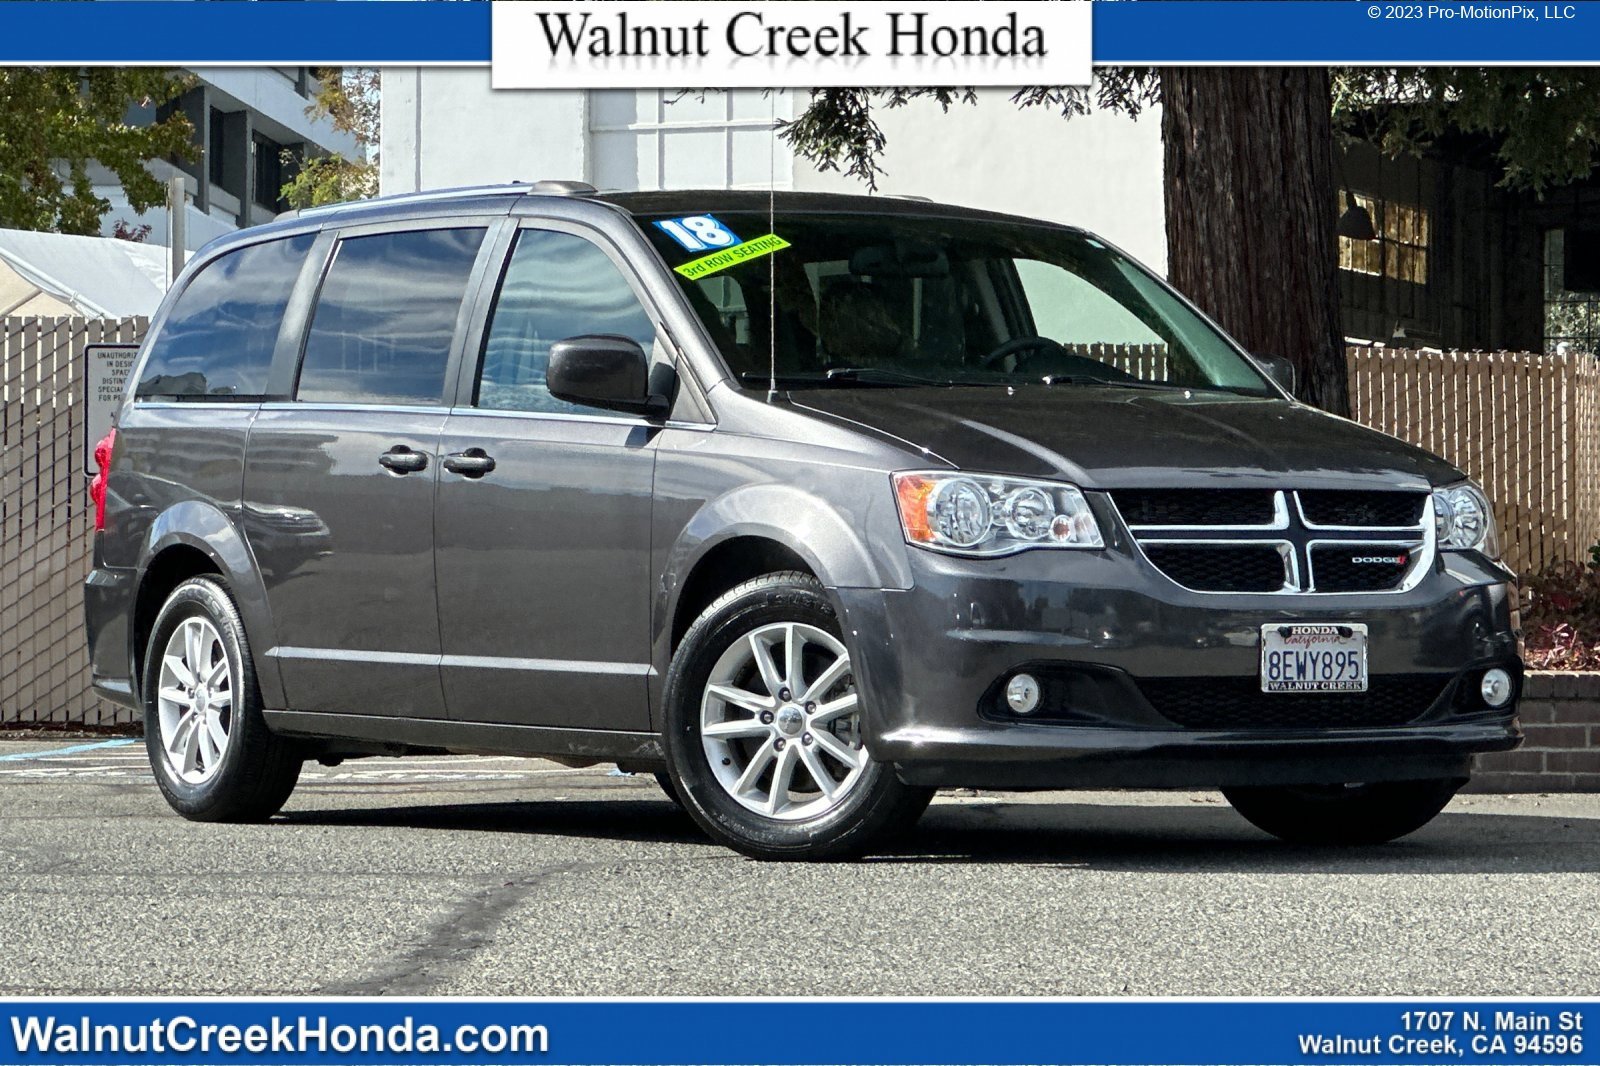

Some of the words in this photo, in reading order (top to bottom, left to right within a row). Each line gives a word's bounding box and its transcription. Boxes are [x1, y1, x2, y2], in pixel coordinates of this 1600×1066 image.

[660, 216, 733, 250] 18
[682, 263, 706, 277] 3rd
[704, 252, 734, 269] ROW
[732, 236, 783, 259] SEATING
[1291, 626, 1339, 635] HONDA
[1268, 650, 1359, 681] 8EWY895
[1269, 681, 1320, 690] WALNUT
[1320, 681, 1361, 690] CREEK
